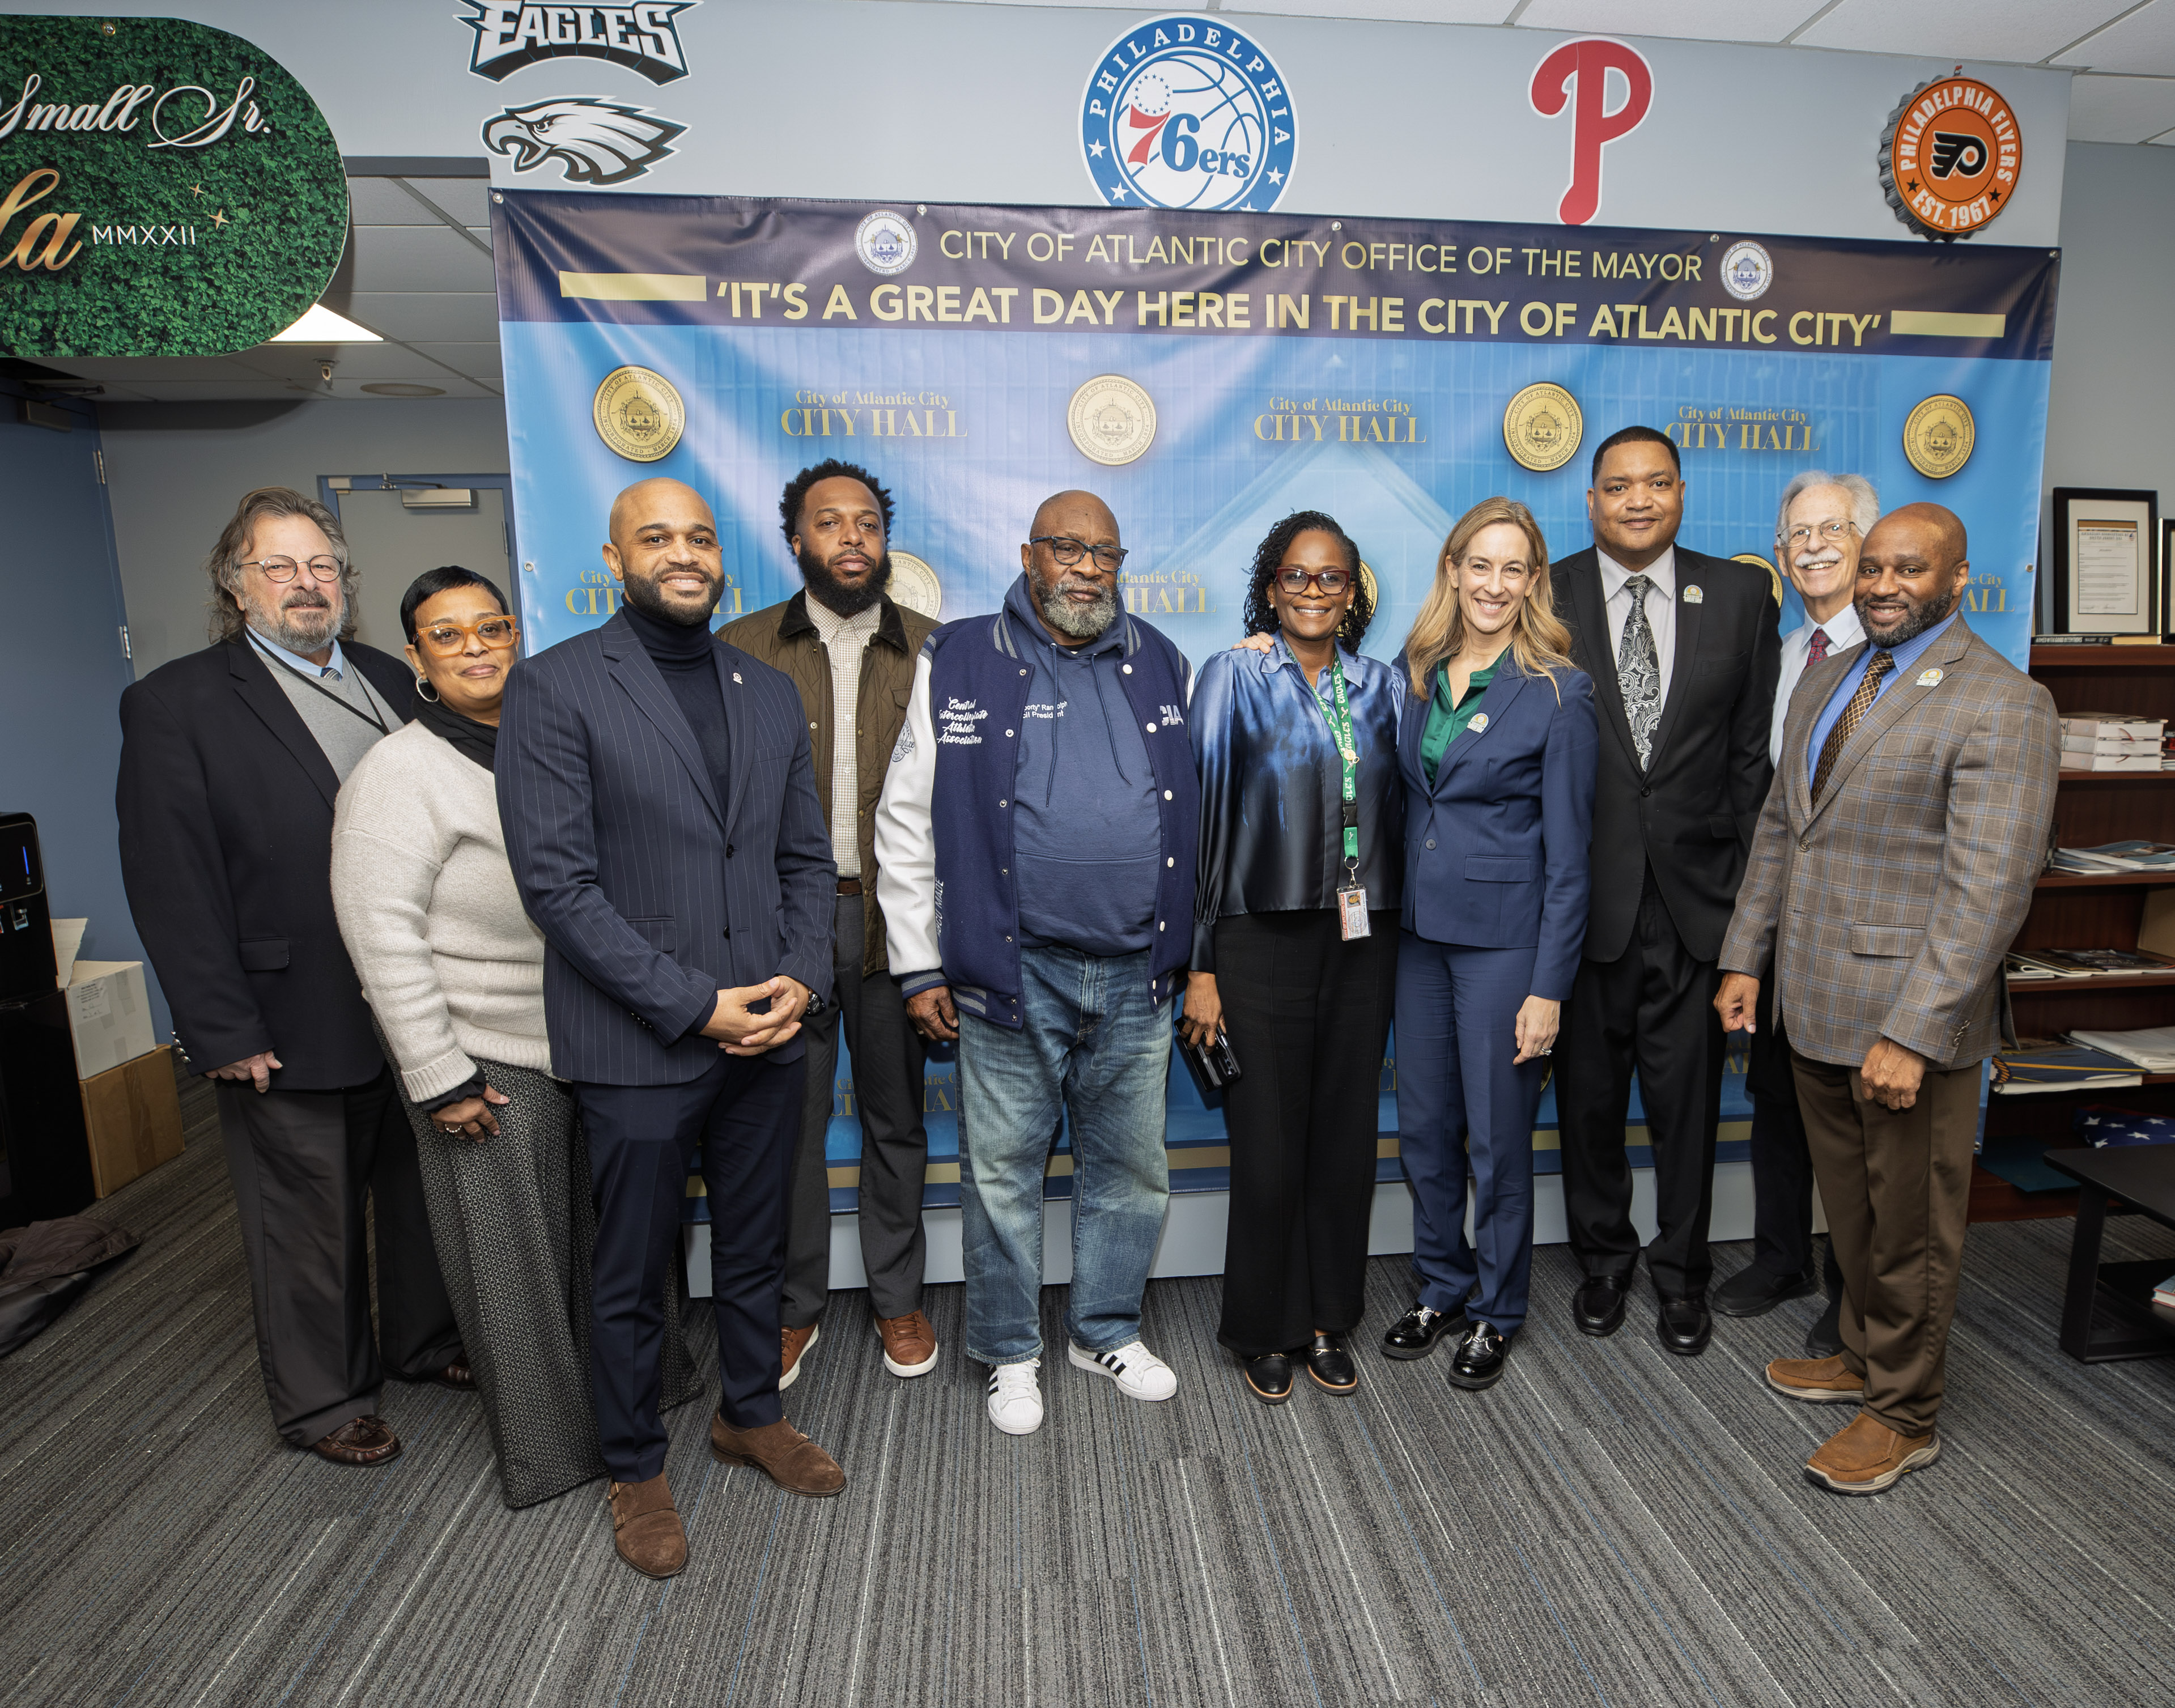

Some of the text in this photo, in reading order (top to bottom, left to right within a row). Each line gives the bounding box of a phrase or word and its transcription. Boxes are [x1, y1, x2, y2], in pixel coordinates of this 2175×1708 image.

[475, 2, 679, 72] EAGLES
[1090, 23, 1290, 146] PHILADELPHIA
[147, 77, 271, 147] Sr.
[1128, 104, 1251, 179] 76ers
[1900, 86, 2016, 183] PHILADELPHIA FLYERS
[1912, 189, 1991, 227] EST. 1967
[92, 226, 196, 245] MMXXII
[874, 212, 902, 220] ATLANTIC
[903, 221, 912, 232] CITY
[940, 230, 1702, 282] CITY OF ATLANTIC CITY OFFICE OF THE MAYOR
[822, 285, 858, 320] A
[870, 285, 1018, 324] GREAT
[1033, 289, 1124, 326] DAY
[1138, 292, 1250, 329] HERE
[1266, 294, 1309, 330] IN
[1323, 296, 1404, 332] THE
[1418, 299, 1509, 336] CITY
[1520, 301, 1577, 337] OF
[1588, 304, 1778, 343] ATLANTIC
[605, 386, 614, 401] CITY
[624, 374, 660, 387] ATLANTIC
[661, 388, 674, 402] CITY
[796, 390, 950, 409] City of Atlantic City
[1079, 394, 1089, 407] CITY
[1101, 383, 1134, 394] ATLANTIC
[1135, 395, 1146, 409] CITY
[1269, 397, 1412, 416] City of Atlantic City
[1515, 401, 1524, 414] CITY
[1536, 390, 1565, 401] ATLANTIC
[1566, 402, 1574, 417] CITY
[1679, 405, 1808, 425] City of Atlantic City
[1914, 411, 1923, 424] CITY
[1934, 402, 1962, 413] ATLANTIC
[602, 415, 644, 454] INCORPORATED
[653, 436, 671, 452] MARCH
[781, 409, 968, 437] CITY HALL
[1254, 414, 1427, 443] CITY HALL
[1664, 422, 1821, 451] CITY HALL
[1076, 422, 1113, 458] INCORPORATED
[1123, 440, 1143, 456] MARCH
[1511, 427, 1542, 464] INCORPORATED
[1550, 448, 1569, 462] MARCH
[580, 570, 613, 587] City
[892, 559, 931, 585] LANTIC CITY
[1171, 570, 1201, 587] City
[1979, 573, 2003, 588] City
[566, 588, 626, 615] CIT
[1126, 588, 1217, 613] HALL
[1960, 588, 2016, 612] ALL
[1312, 685, 1329, 712] GLES
[1334, 673, 1345, 704] EAGLES
[948, 696, 976, 711] Central
[1031, 709, 1064, 719] Presidnt
[1042, 700, 1068, 711] Ranolph
[936, 732, 983, 745] Association
[1342, 722, 1353, 750] AGLES
[1345, 777, 1353, 801] GLES
[935, 877, 944, 909] MADE
